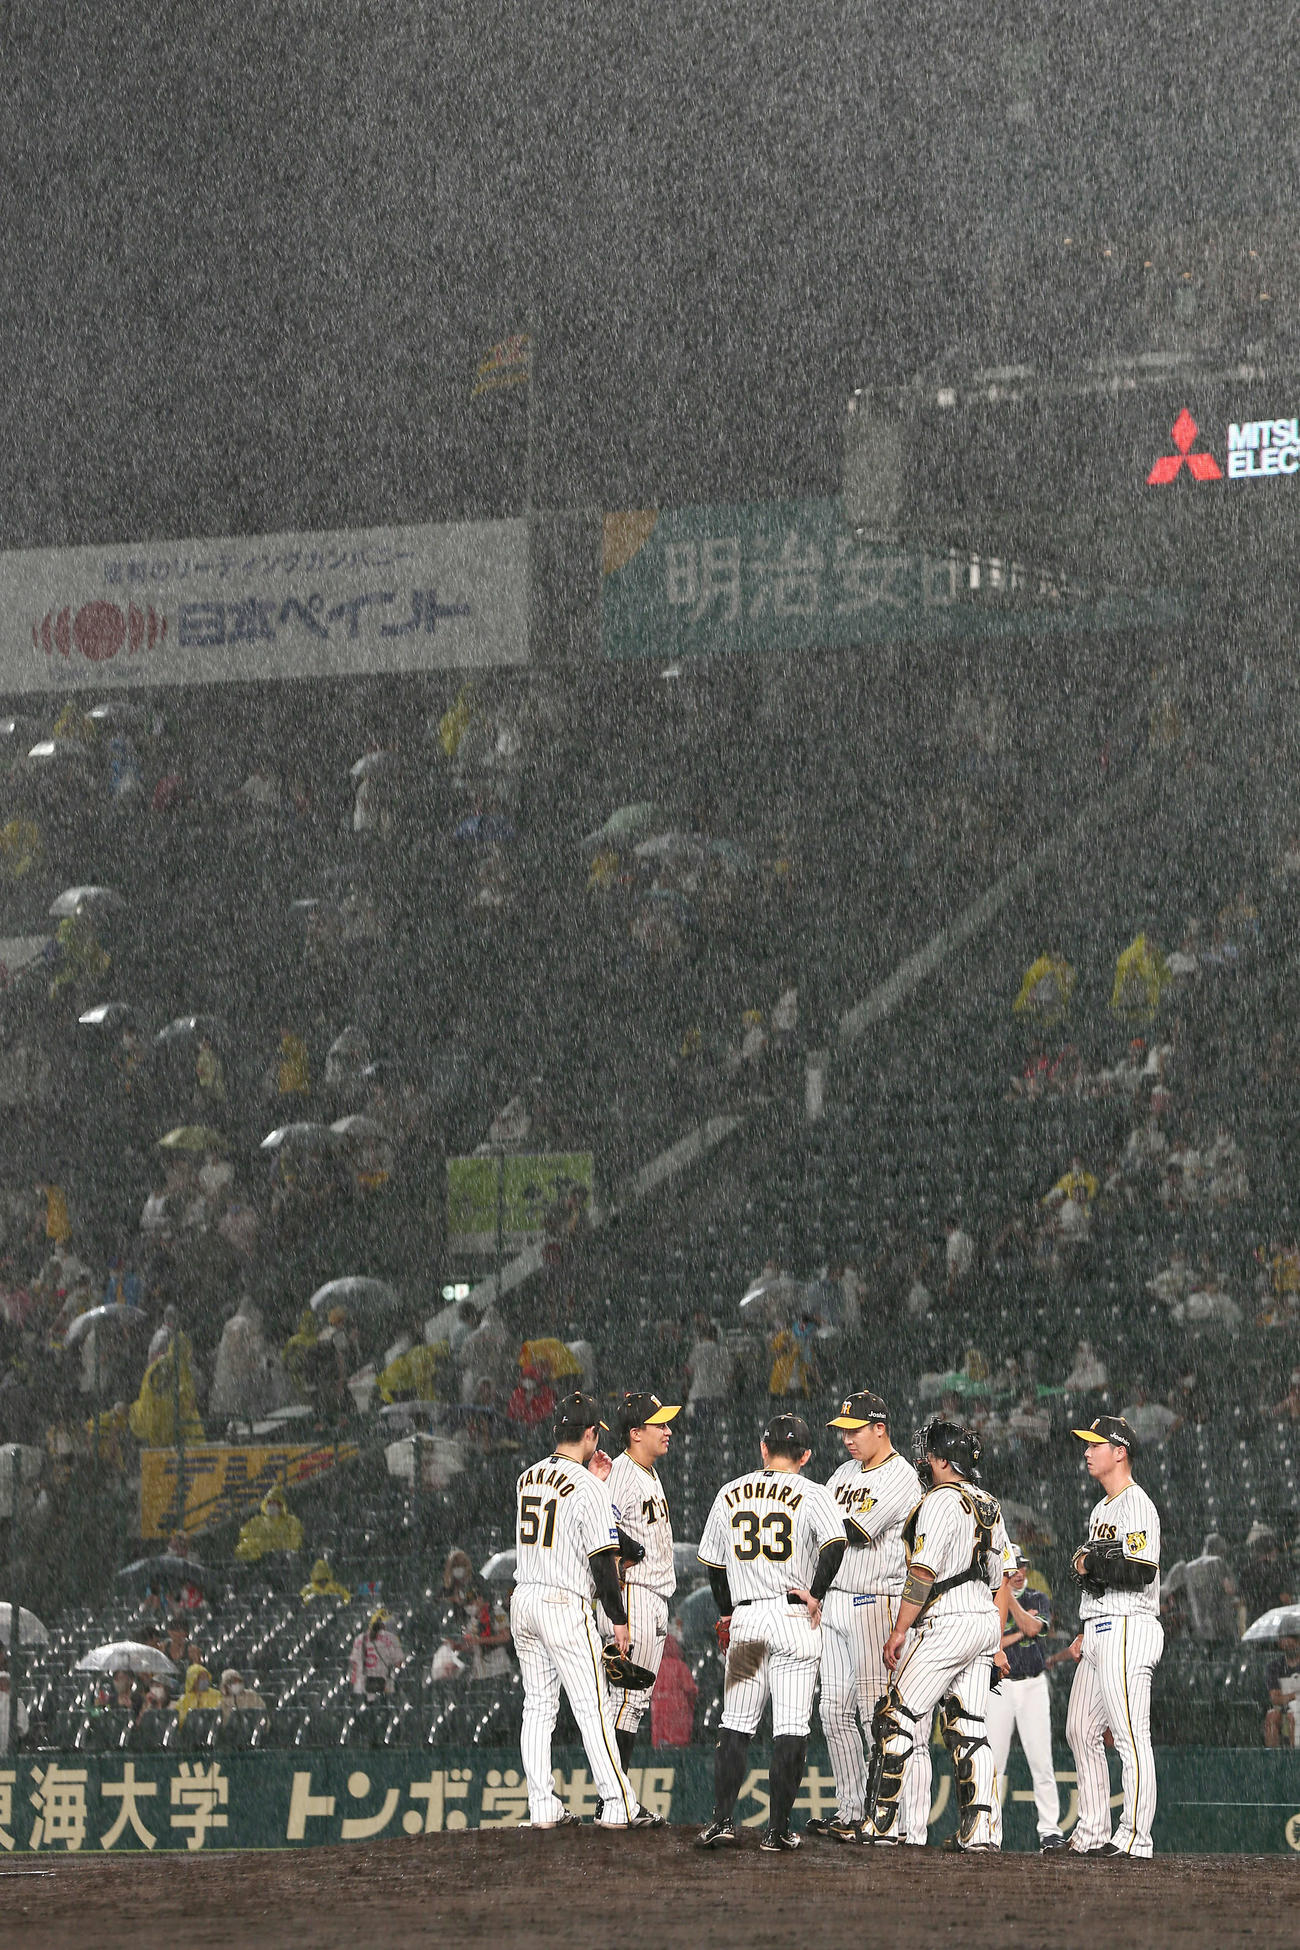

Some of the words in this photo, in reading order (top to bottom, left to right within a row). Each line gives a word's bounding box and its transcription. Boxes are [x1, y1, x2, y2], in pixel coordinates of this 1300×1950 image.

[178, 590, 471, 646] 日本ペイント
[868, 1411, 887, 1419] Joshin
[1110, 1432, 1130, 1447] Joshin
[724, 1482, 803, 1511] ITOHARA
[520, 1495, 557, 1549] 51
[731, 1510, 793, 1562] 33
[854, 1595, 876, 1605] Joshin
